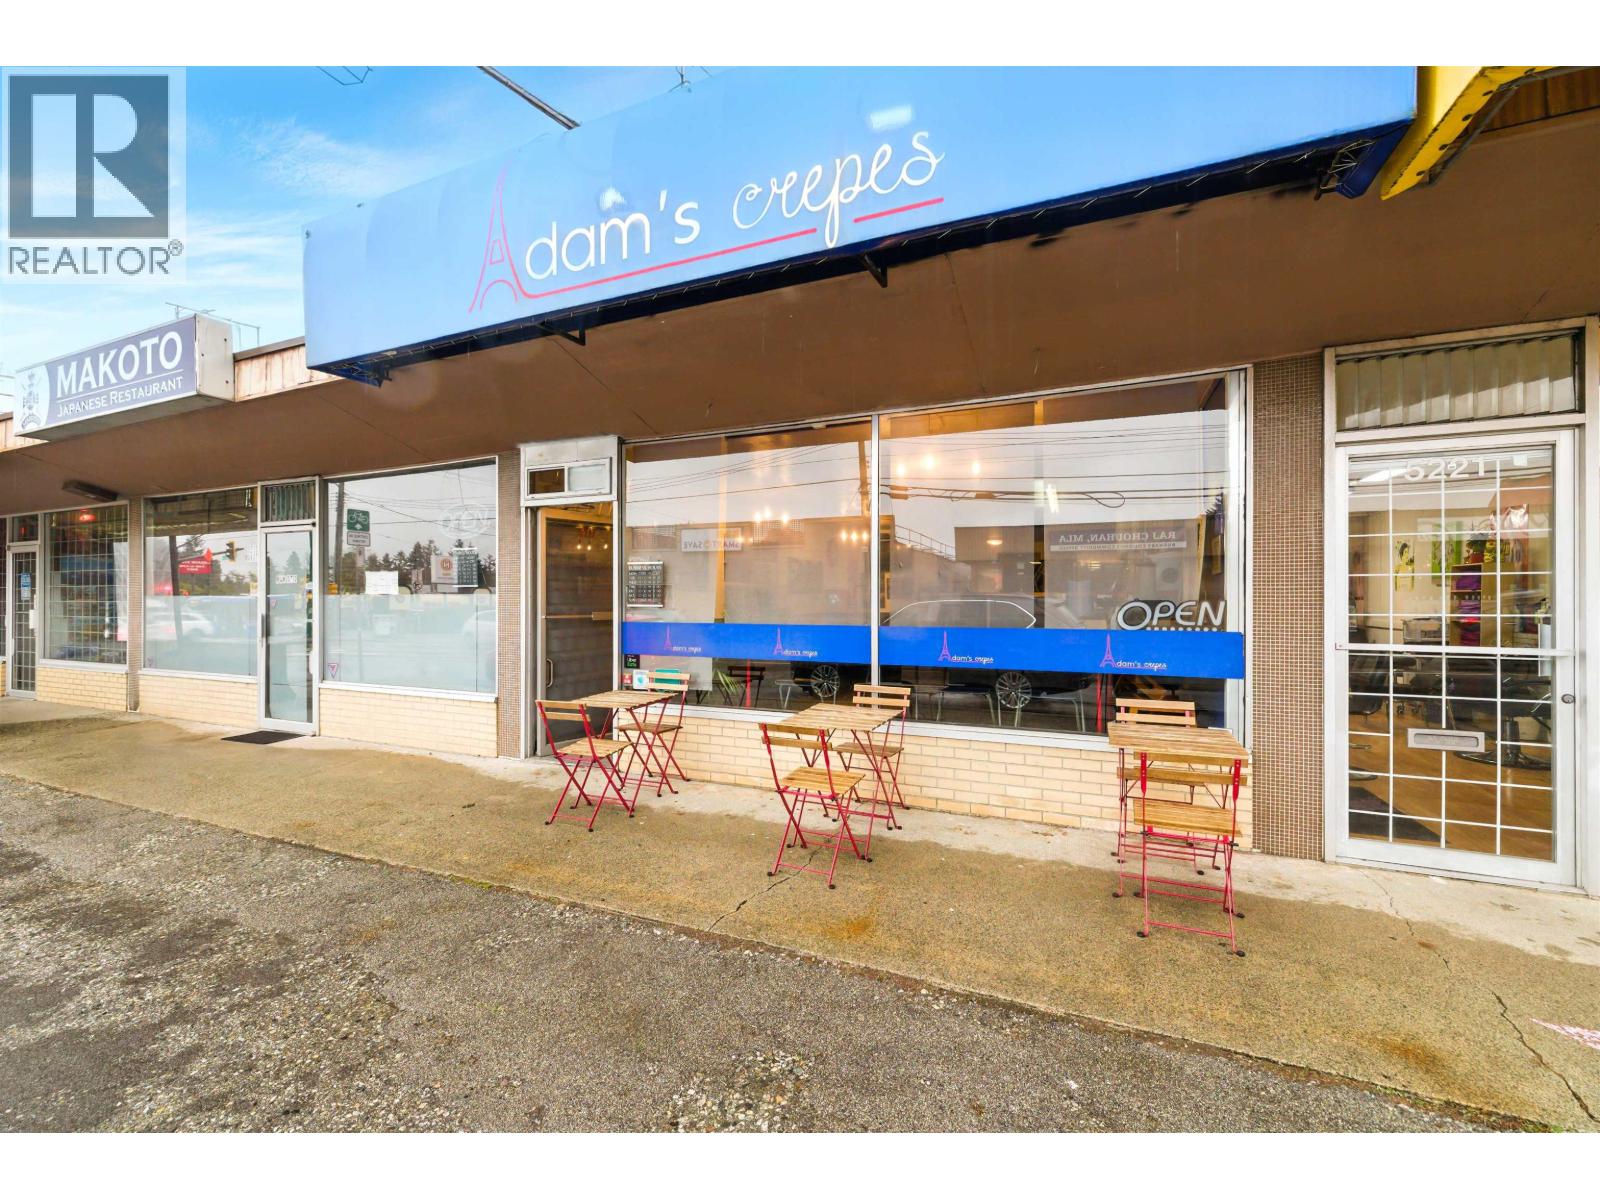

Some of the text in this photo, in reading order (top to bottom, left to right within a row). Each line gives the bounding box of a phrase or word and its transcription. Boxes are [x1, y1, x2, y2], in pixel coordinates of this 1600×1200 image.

[468, 130, 945, 314] Adam's crepes
[57, 331, 183, 398] MAKOTO
[57, 376, 183, 418] JAPANESE RESTAURANT
[1404, 456, 1485, 482] 5221
[1117, 601, 1226, 631] OPEN
[1100, 632, 1141, 668] Adam's
